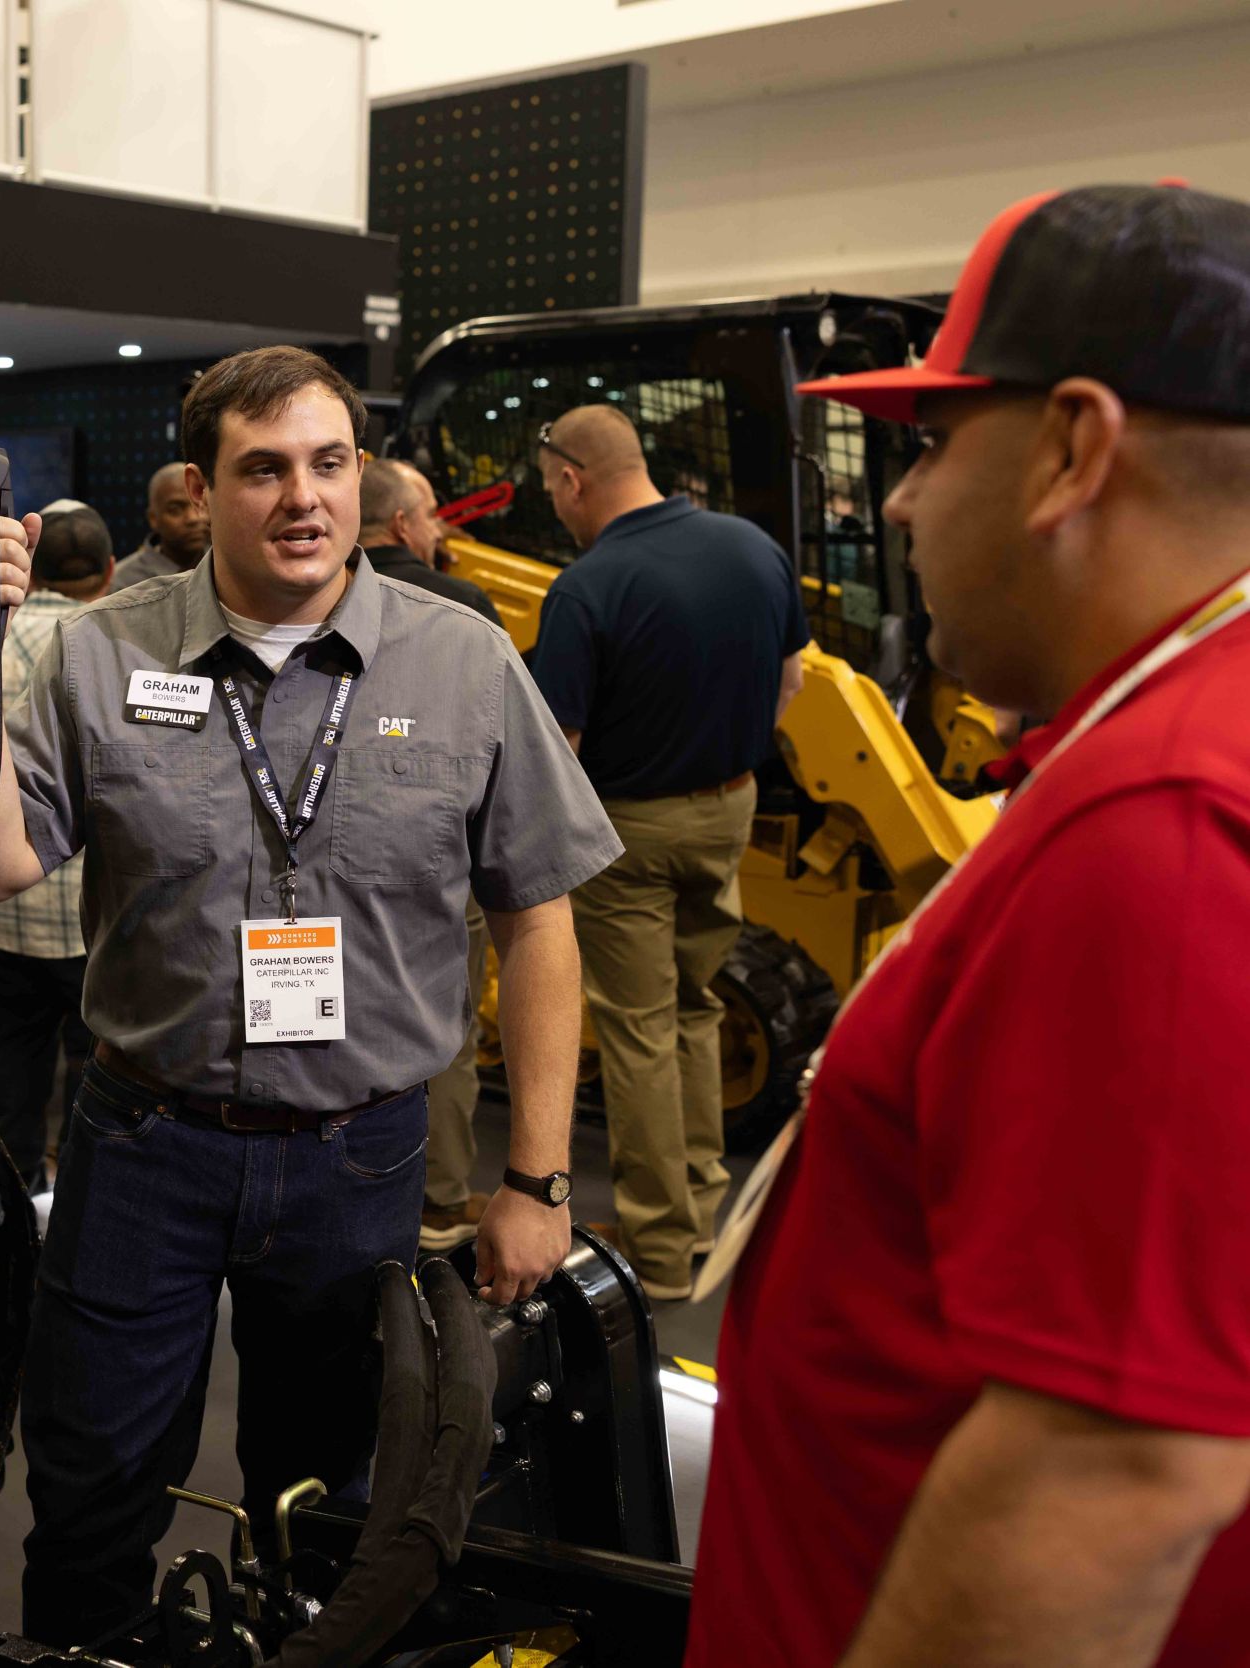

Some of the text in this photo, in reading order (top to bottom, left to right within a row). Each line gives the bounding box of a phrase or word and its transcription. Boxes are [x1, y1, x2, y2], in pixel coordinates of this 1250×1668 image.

[142, 680, 200, 695] GRAHAM
[152, 693, 186, 703] BOWERS
[330, 672, 353, 723] CATERPILLAR
[135, 708, 196, 725] CATERPILLAR
[230, 697, 257, 751] CATERPILLAR
[378, 716, 412, 738] CAT
[302, 764, 326, 820] CATERPILLAR
[250, 956, 335, 966] GRAHAM BOWERS
[256, 969, 313, 977] CATERPILLAR
[321, 999, 335, 1017] E
